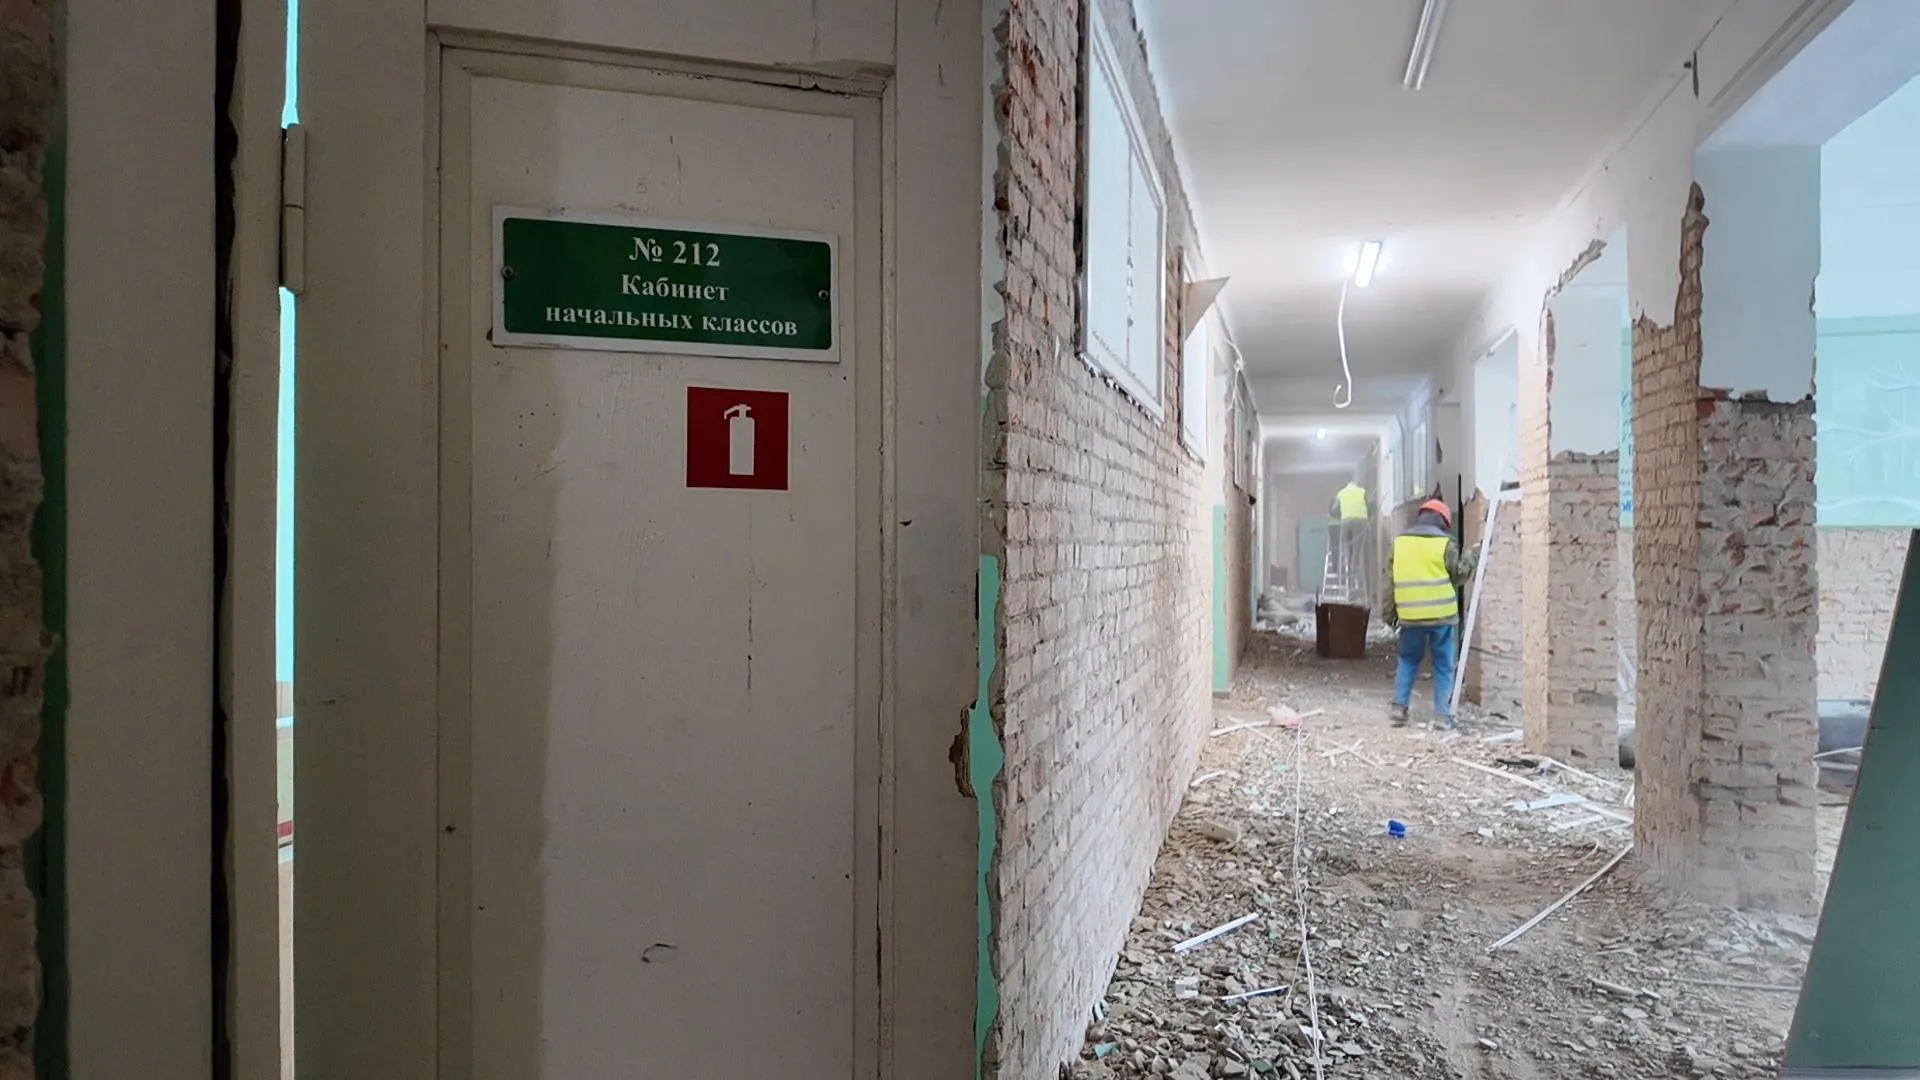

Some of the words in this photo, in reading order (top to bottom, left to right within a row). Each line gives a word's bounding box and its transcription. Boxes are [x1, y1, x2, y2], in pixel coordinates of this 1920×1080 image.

[629, 237, 663, 263] №
[672, 240, 720, 267] 212
[621, 274, 729, 301] Кабинет
[545, 306, 693, 329] начальных
[702, 316, 798, 336] классов
